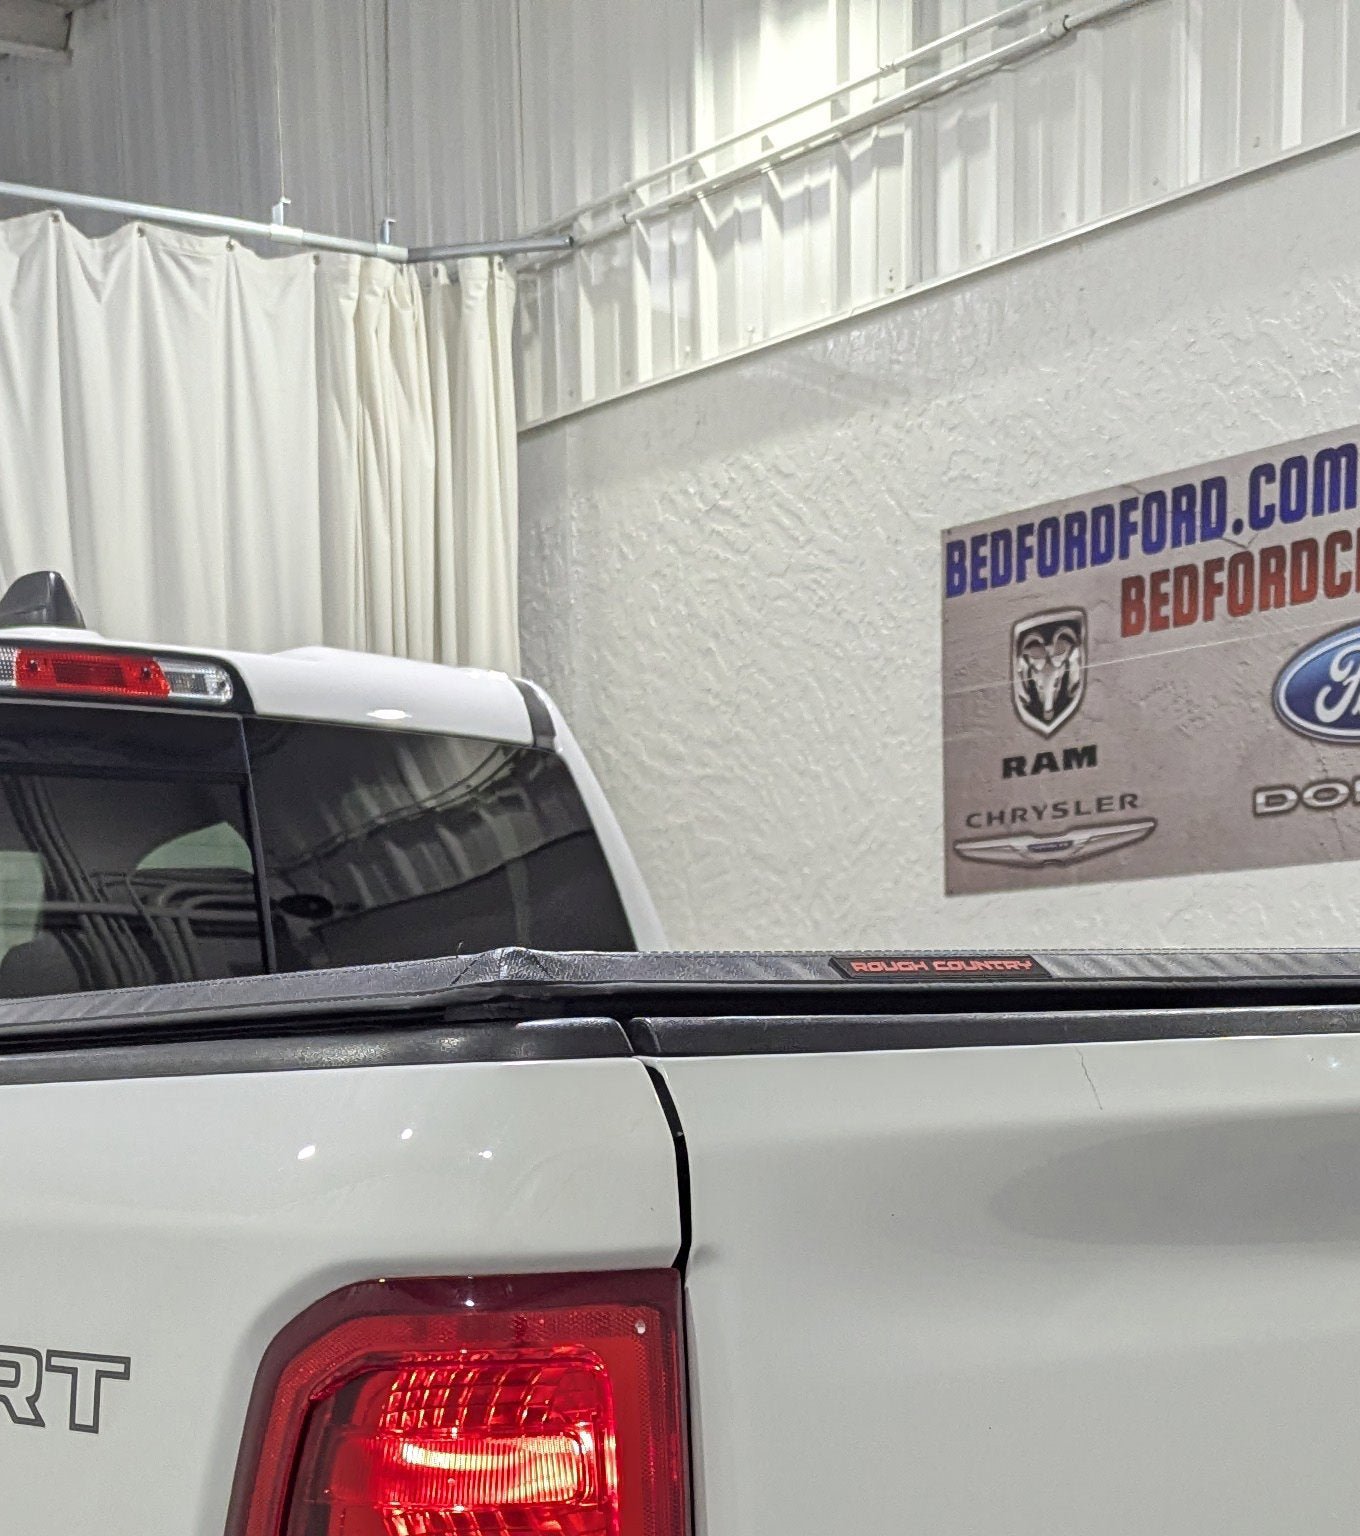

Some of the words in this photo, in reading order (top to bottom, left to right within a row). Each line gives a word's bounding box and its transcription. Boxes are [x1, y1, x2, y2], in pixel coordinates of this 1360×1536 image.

[945, 441, 1359, 599] BEDFORDFORD.COM
[1002, 744, 1097, 779] RAM
[965, 792, 1139, 829] CHRYSLER
[850, 960, 928, 972] ROUGH
[933, 959, 1032, 972] COUNTRY
